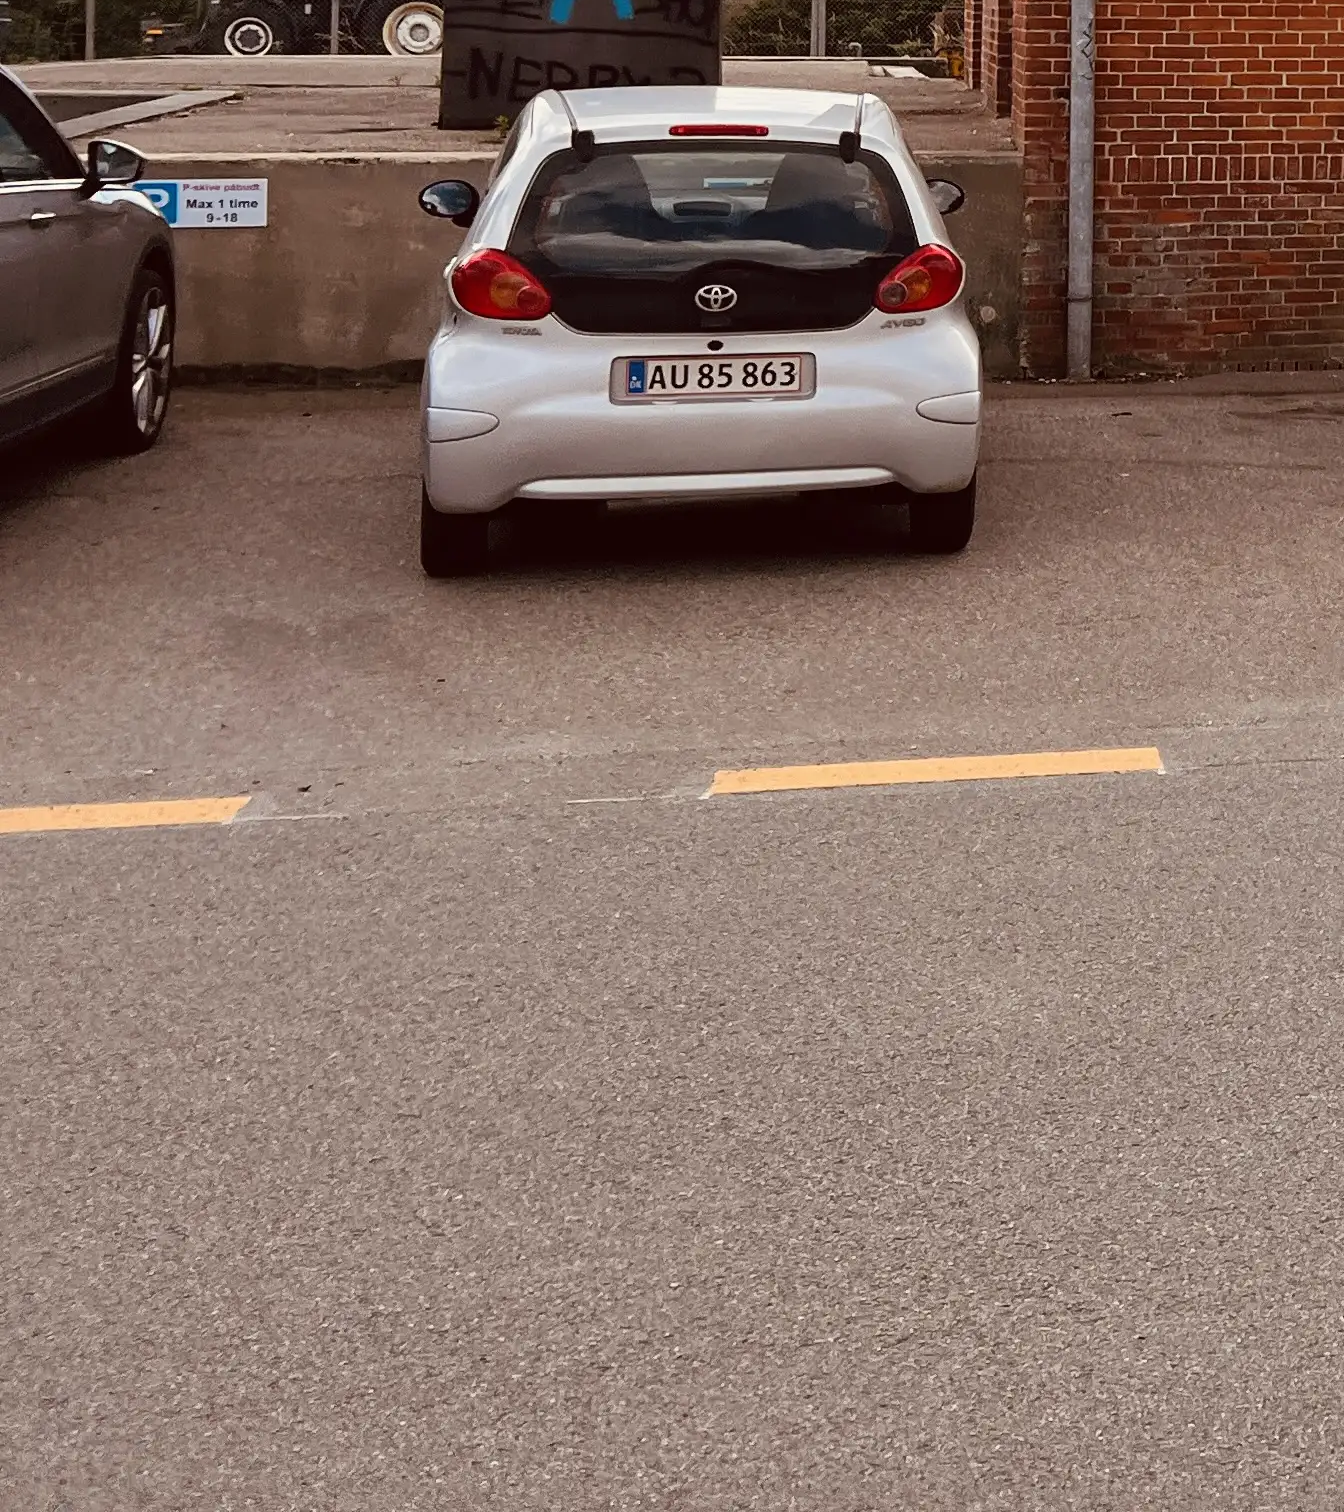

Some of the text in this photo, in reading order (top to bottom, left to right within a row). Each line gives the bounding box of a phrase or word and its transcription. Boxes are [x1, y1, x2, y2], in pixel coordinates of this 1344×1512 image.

[186, 199, 258, 208] Max 1 time
[206, 213, 238, 223] 9-18
[649, 361, 796, 389] AU 85 863
